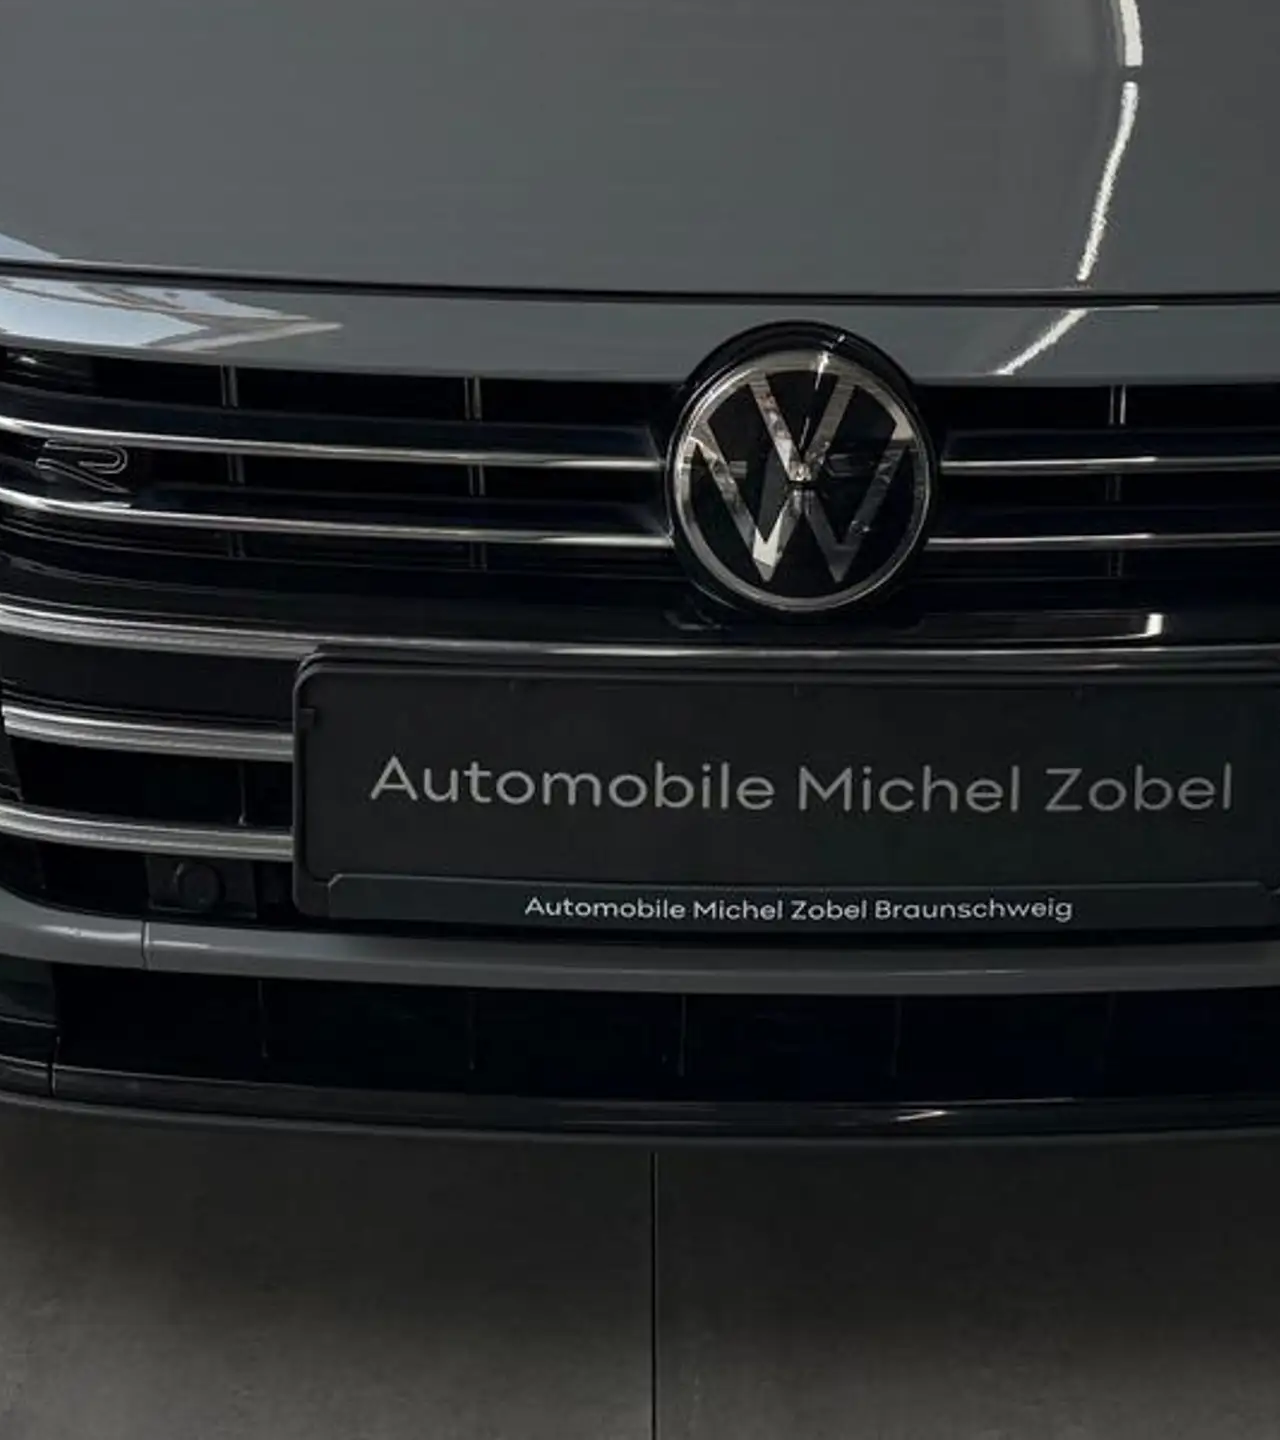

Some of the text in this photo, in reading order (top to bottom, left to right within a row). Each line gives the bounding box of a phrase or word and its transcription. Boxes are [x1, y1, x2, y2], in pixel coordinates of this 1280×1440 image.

[370, 756, 1232, 813] Automobile Michel Zobel
[524, 896, 1073, 923] Automobile Michel Zobel Braunschweig
